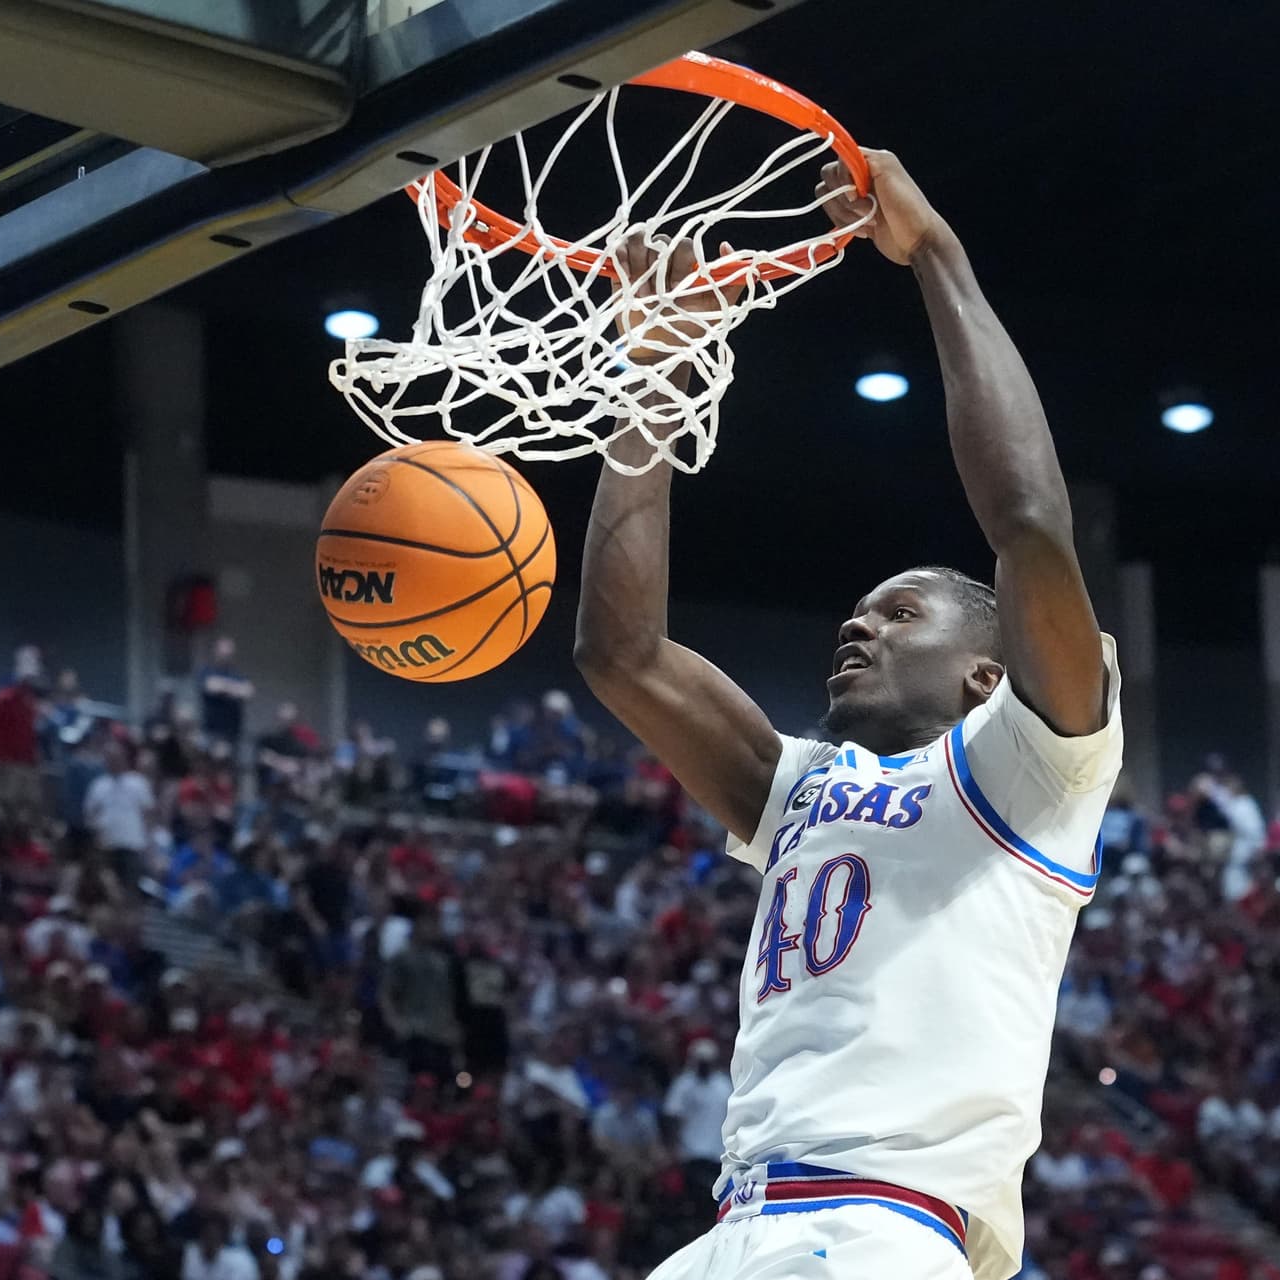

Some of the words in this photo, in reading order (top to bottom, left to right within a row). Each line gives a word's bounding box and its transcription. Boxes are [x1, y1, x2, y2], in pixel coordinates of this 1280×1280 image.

[320, 563, 395, 603] NCAA
[755, 852, 872, 1003] 40
[734, 1181, 757, 1204] KU
